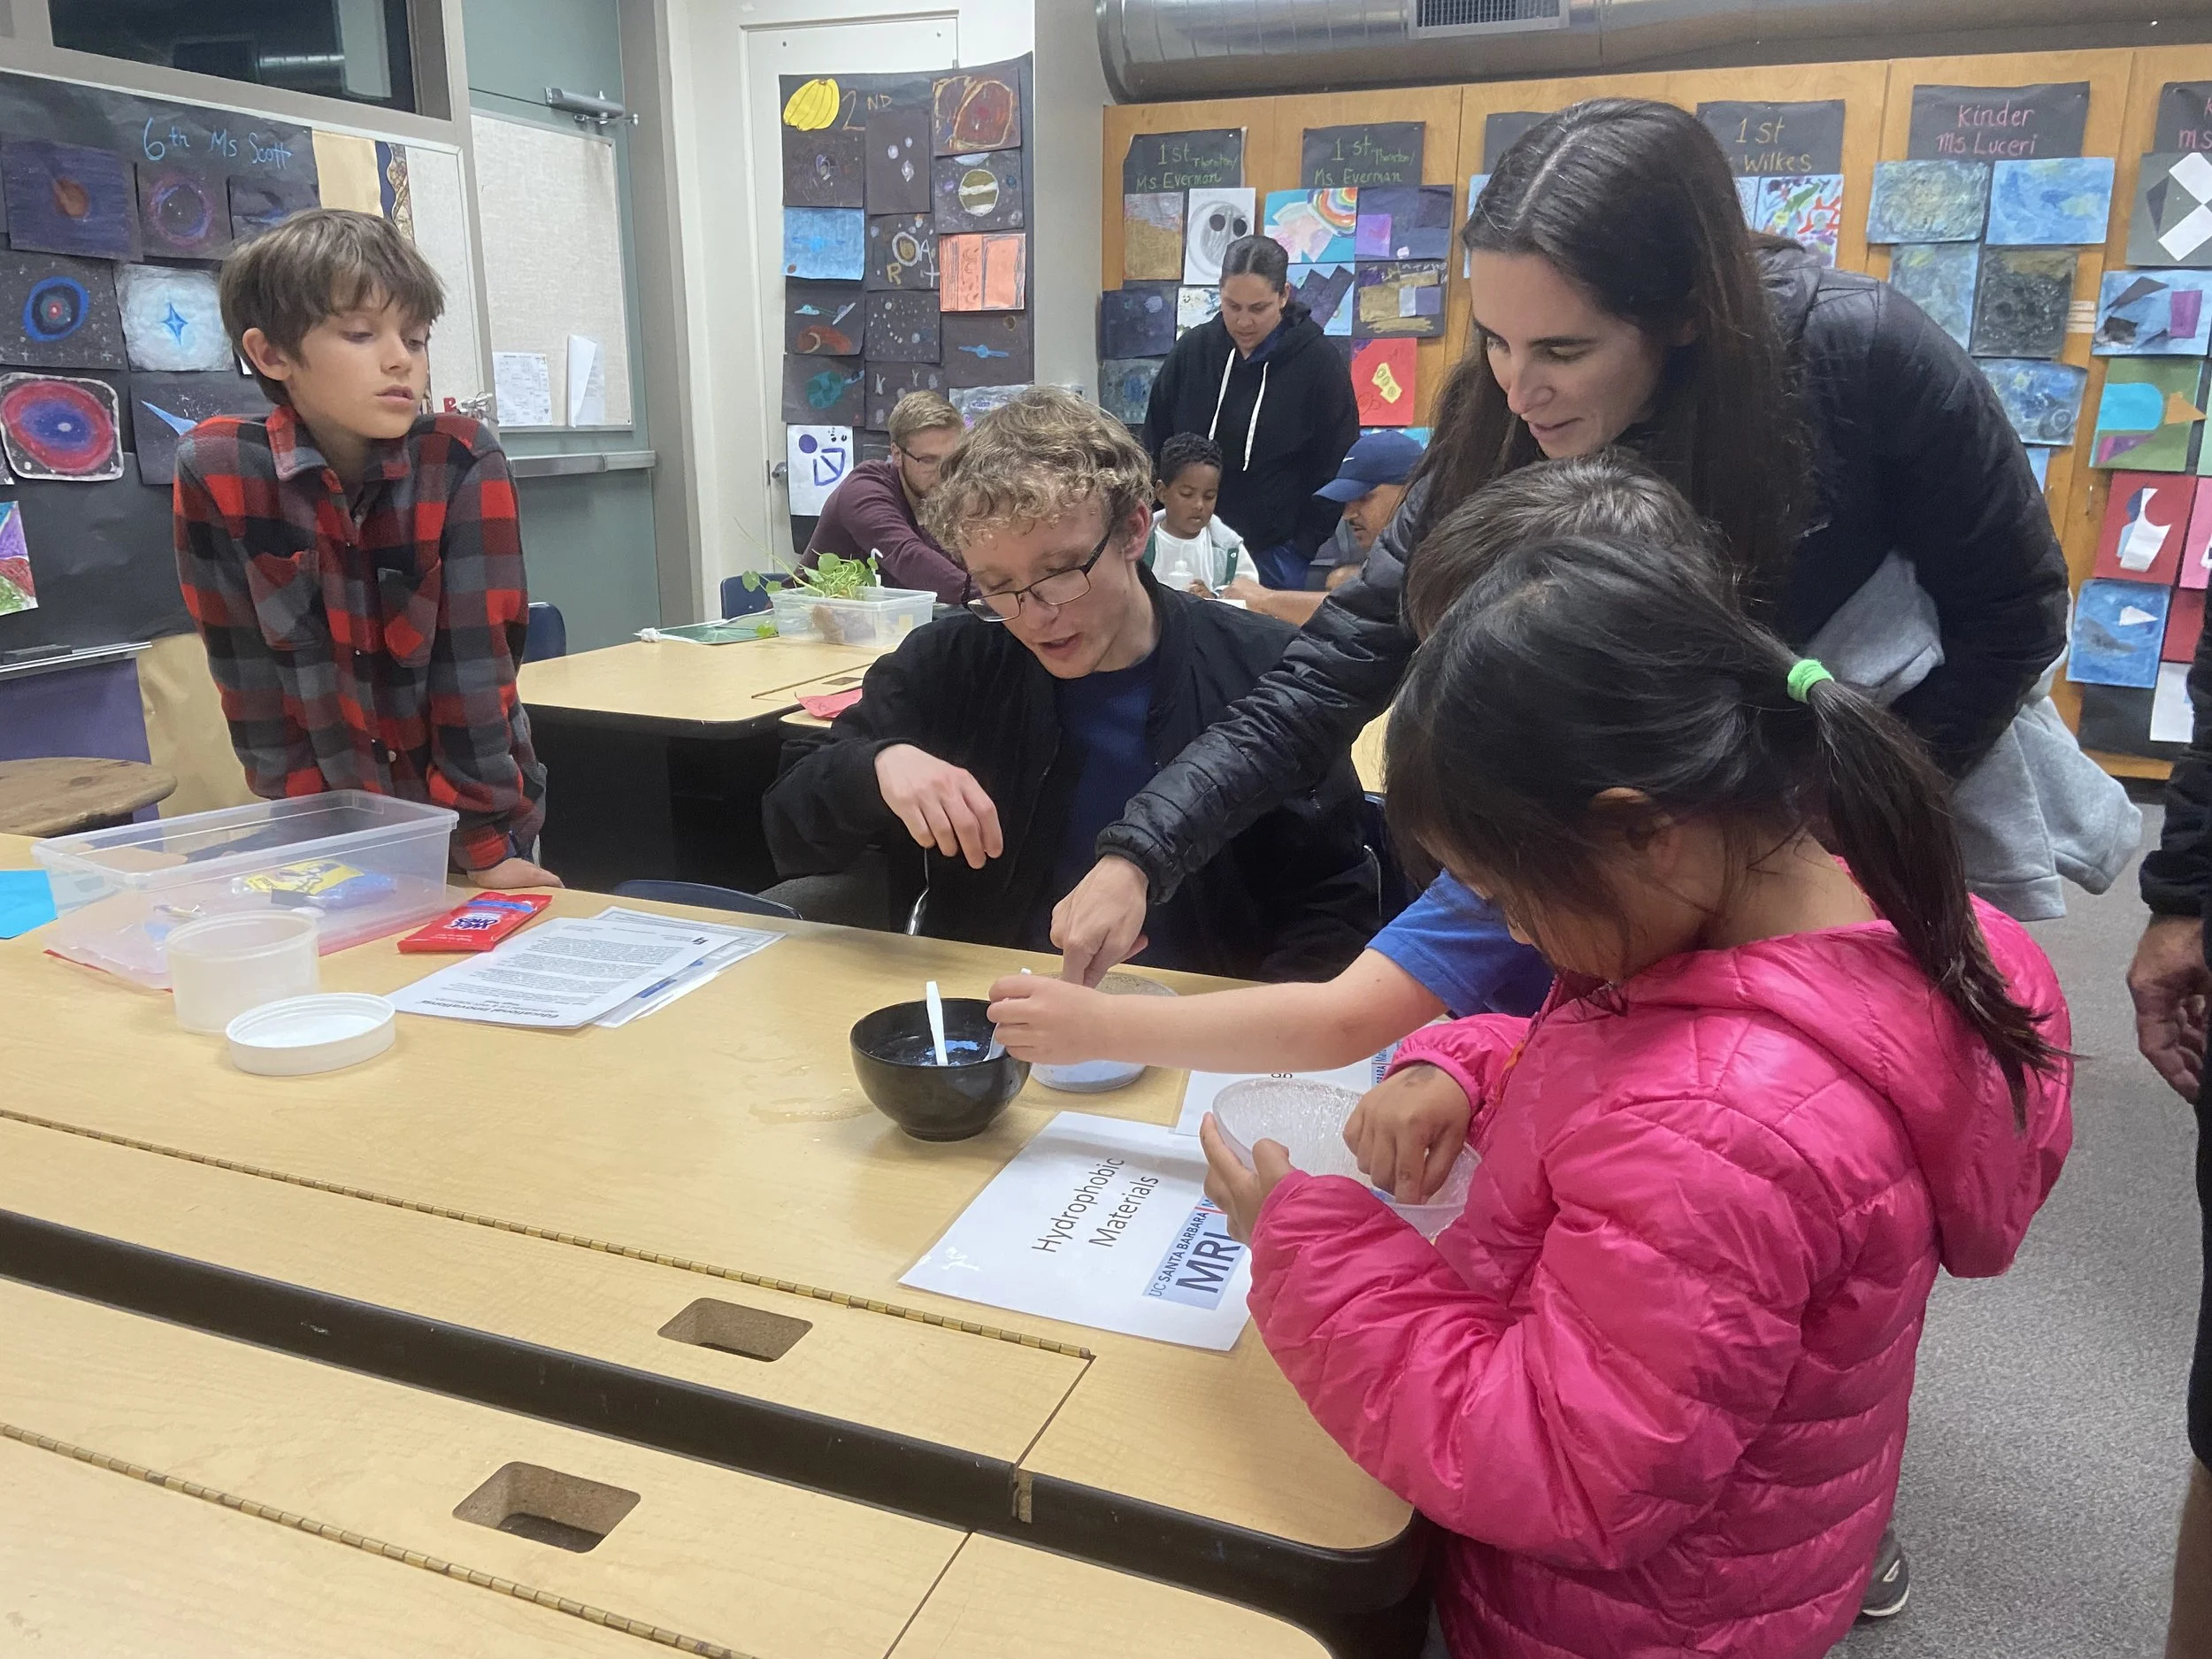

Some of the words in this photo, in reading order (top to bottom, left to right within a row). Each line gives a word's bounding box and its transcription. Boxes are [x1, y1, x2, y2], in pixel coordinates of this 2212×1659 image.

[1957, 98, 2035, 128] Kinder
[142, 116, 190, 161] 6th
[208, 127, 237, 157] Ms
[248, 132, 294, 170] Scott
[1734, 115, 1786, 144] 1st
[1973, 130, 2039, 157] Luceri
[1157, 142, 1190, 165] 1st
[1330, 134, 1372, 161] 1st
[1342, 167, 1403, 186] Everman
[1031, 1156, 1125, 1253] Hydrophobic
[1088, 1175, 1159, 1248] Materials
[1177, 1211, 1210, 1251] BARBARA
[1157, 1248, 1185, 1283] SANTA
[1148, 1282, 1167, 1298] UC
